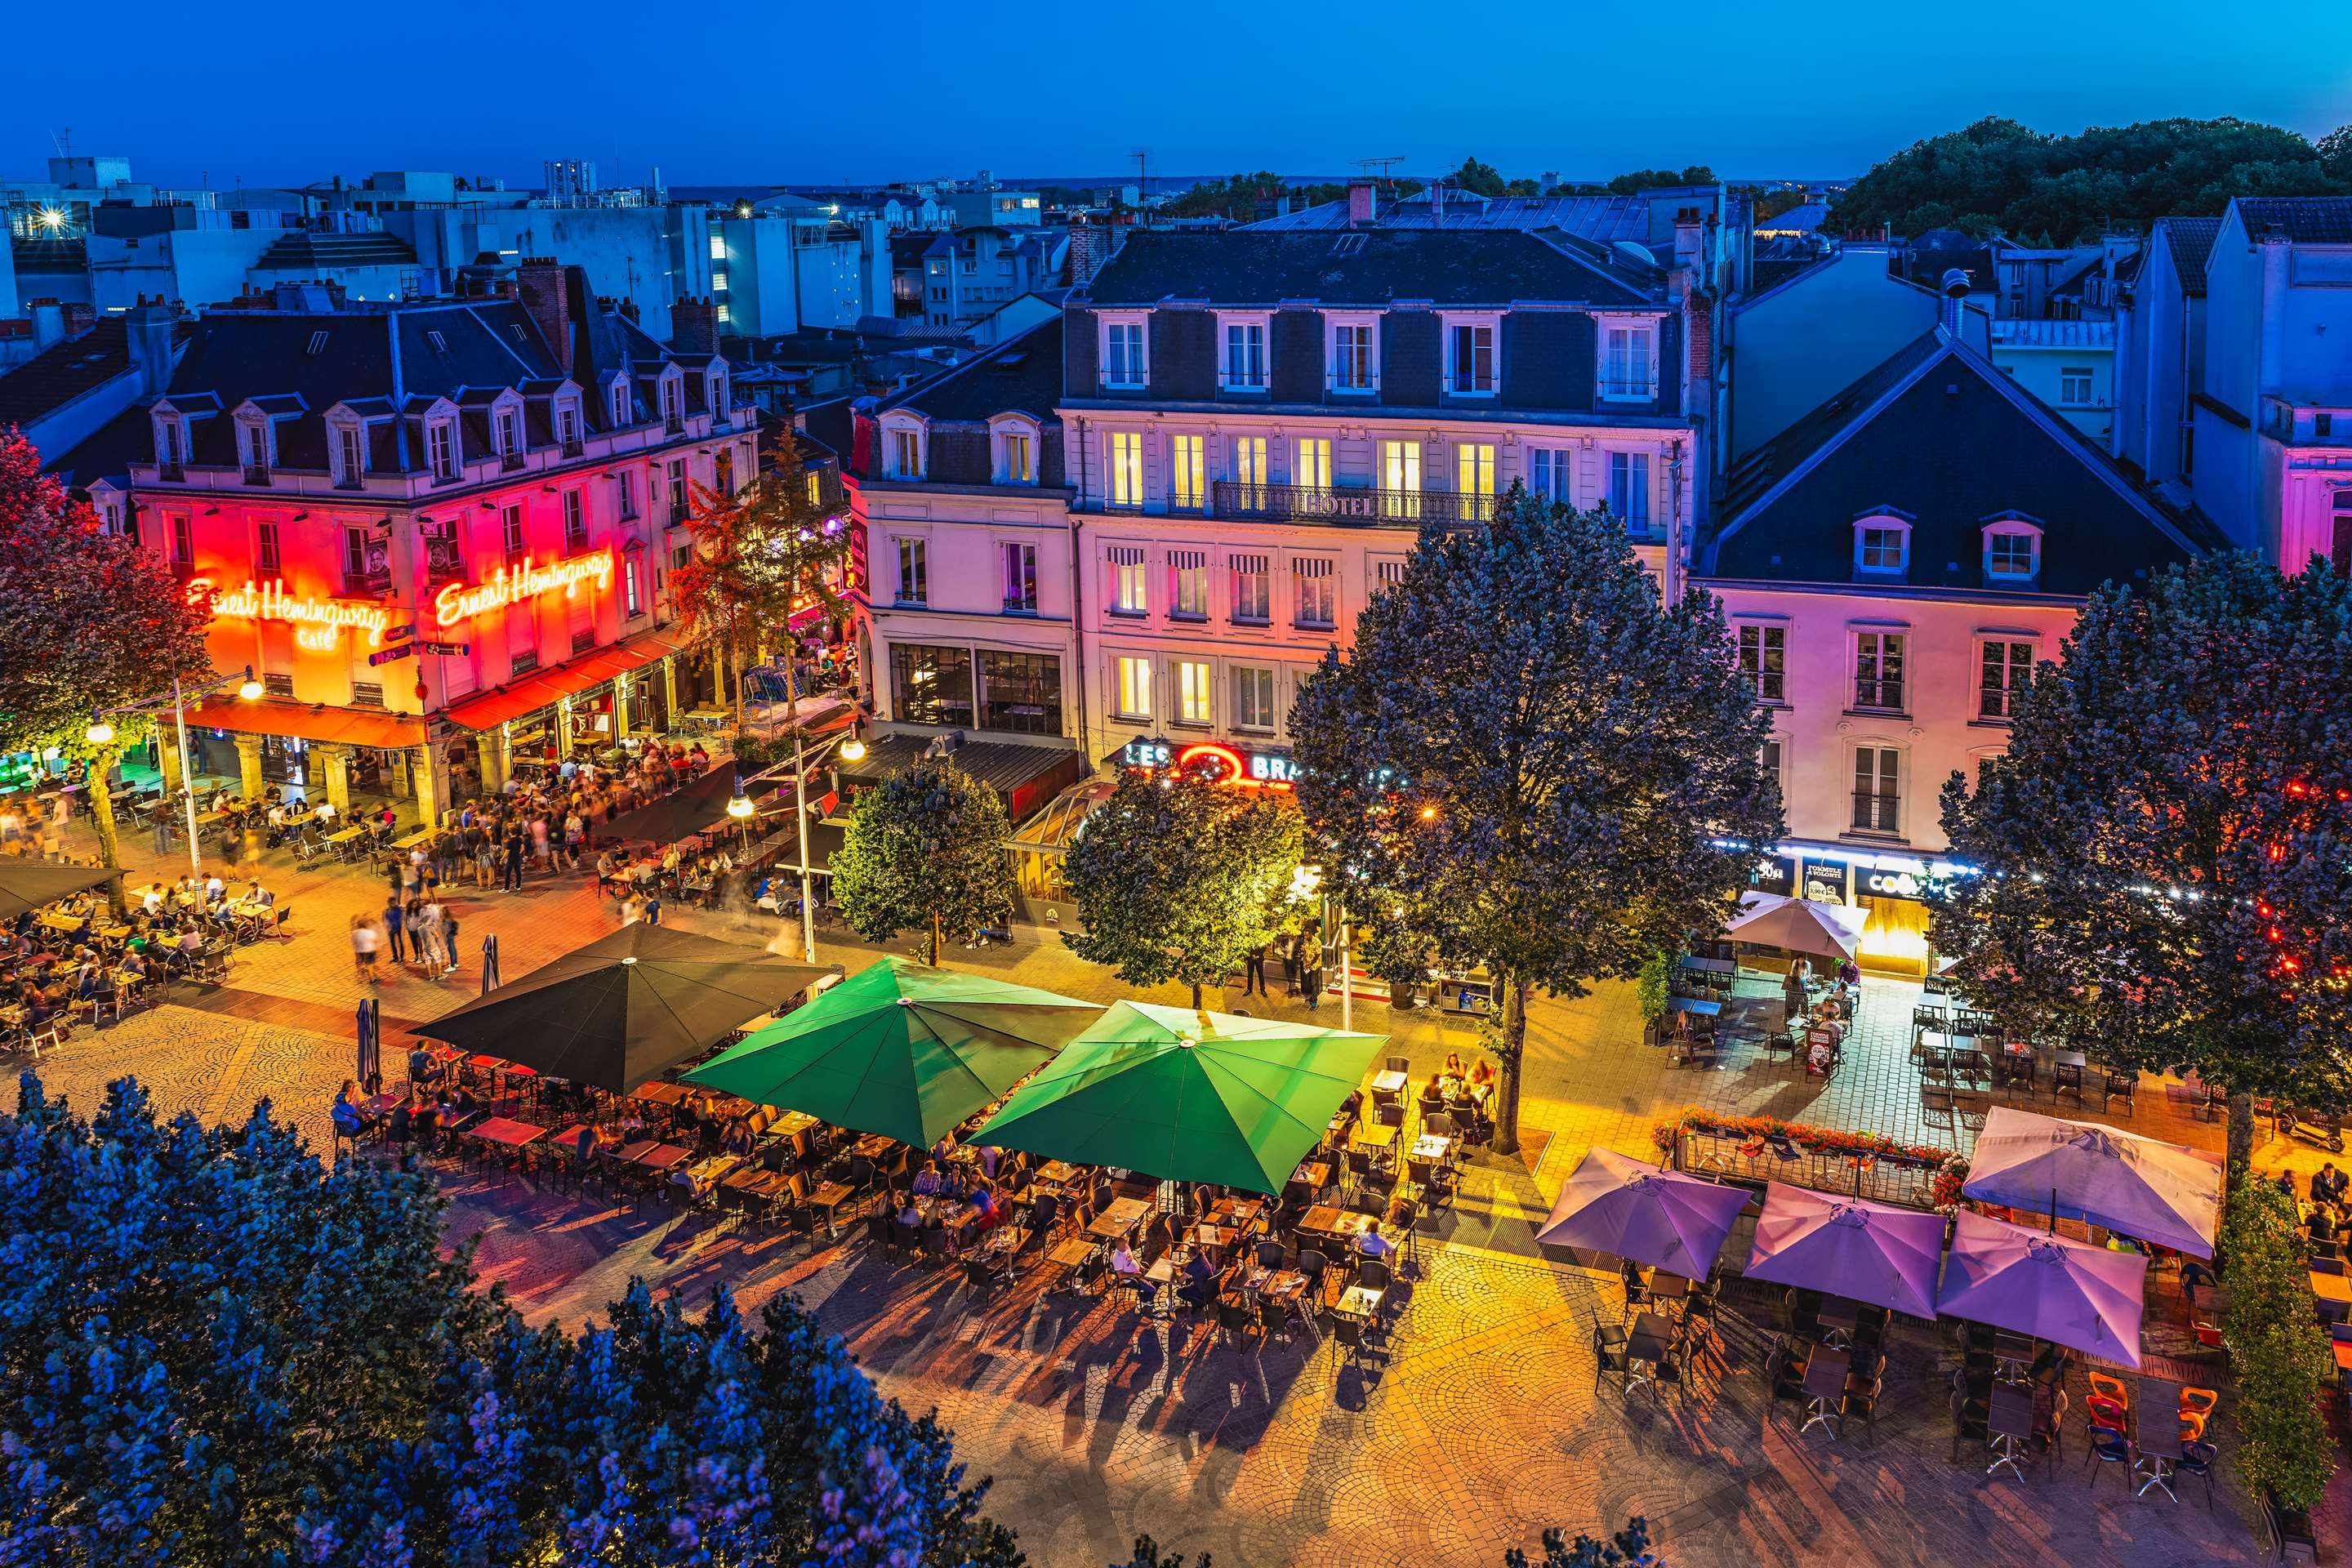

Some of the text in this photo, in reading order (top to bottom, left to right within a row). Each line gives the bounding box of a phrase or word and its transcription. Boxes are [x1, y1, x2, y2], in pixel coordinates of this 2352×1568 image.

[261, 577, 385, 646] Hemingway
[434, 556, 612, 626] Ernest Hemingway
